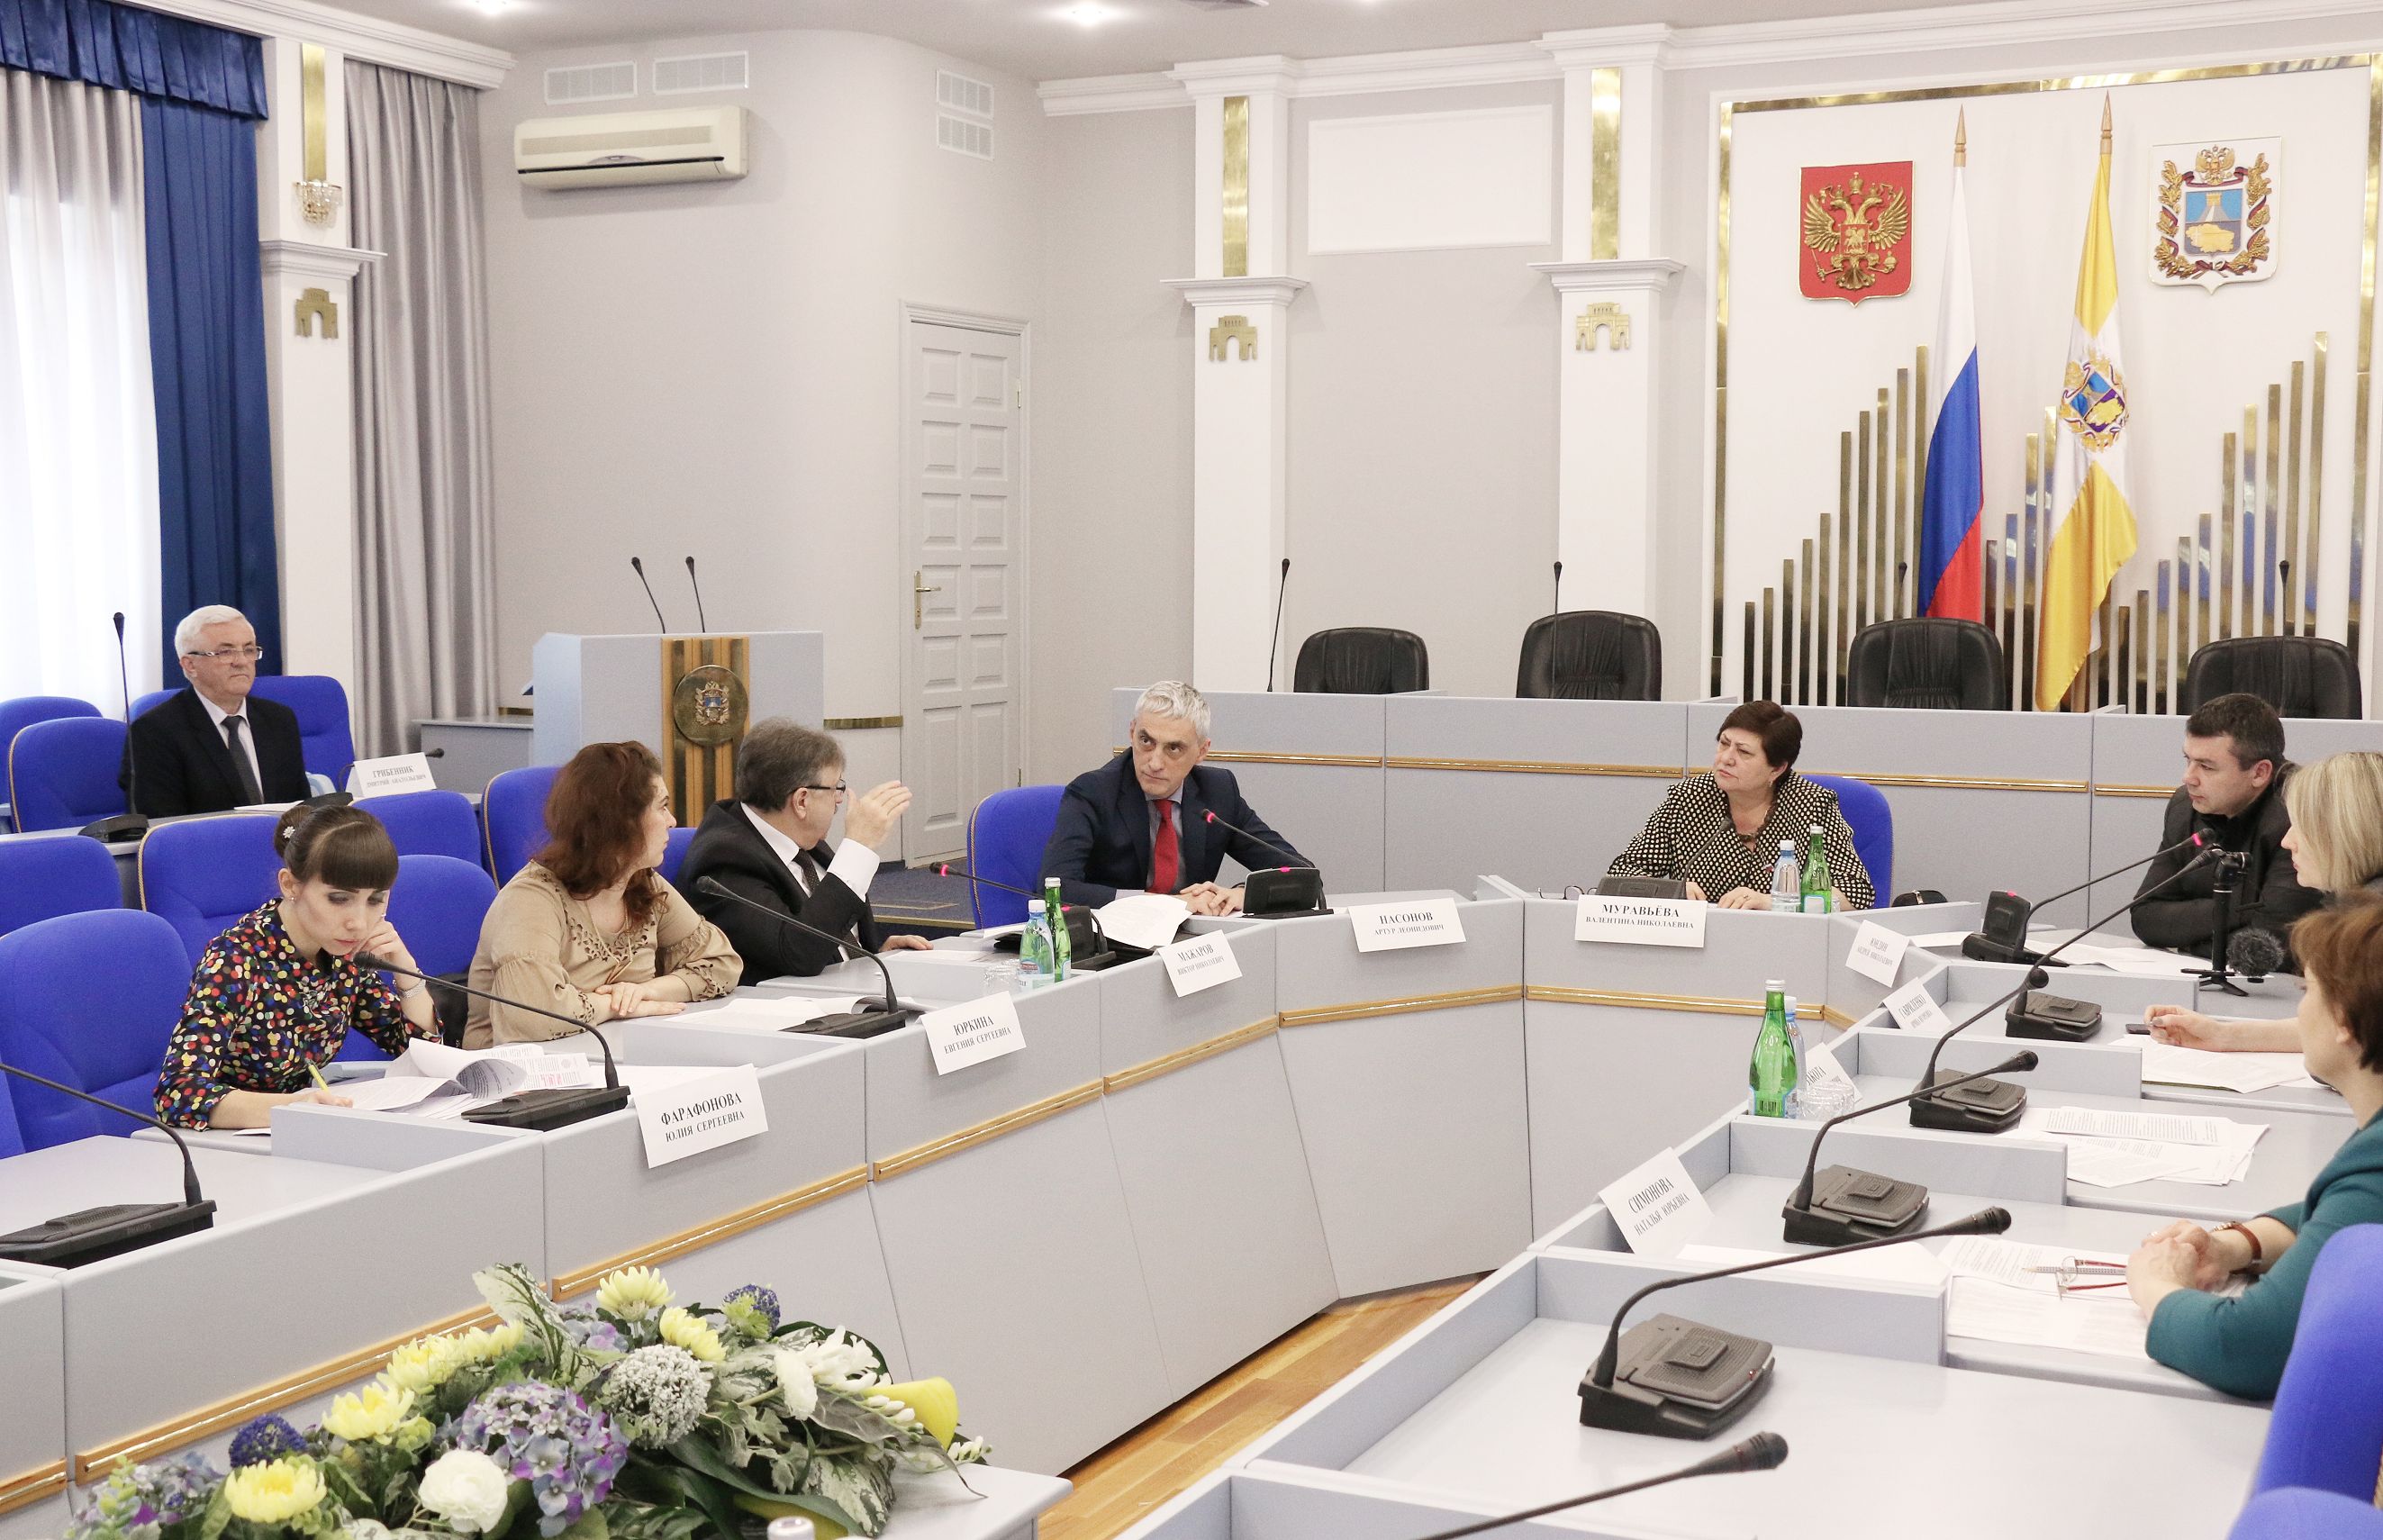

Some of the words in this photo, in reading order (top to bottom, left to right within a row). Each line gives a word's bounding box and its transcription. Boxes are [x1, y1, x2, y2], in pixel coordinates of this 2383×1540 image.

[373, 765, 414, 778] ГРИБЕННИК
[1380, 911, 1434, 924] НАСОНОВ
[1602, 904, 1680, 918] МУРАВЬЁВА
[1375, 928, 1396, 936] АРТУР
[1398, 924, 1445, 934] ЛЕОНИДОВИЧ
[1586, 916, 1635, 925] ВАЛЕНТИНА
[1637, 919, 1694, 929] НИКОЛАЕВНА
[1177, 944, 1214, 961] МАЖАРОВ
[953, 1016, 994, 1036] ЮРКИНА
[944, 1037, 975, 1054] ЕВГЕНИЯ
[976, 1027, 1011, 1044] СЕРГЕЕВНА
[661, 1092, 742, 1125] ФАРАФОНОВА
[666, 1125, 693, 1142] ЮЛИЯ
[696, 1110, 745, 1133] СЕРГЕЕВНА
[1628, 1177, 1674, 1214] СИМОНОВА
[1634, 1210, 1663, 1236] НАТАЛЬЯ
[1661, 1192, 1690, 1217] ЮРЬЕВНА
